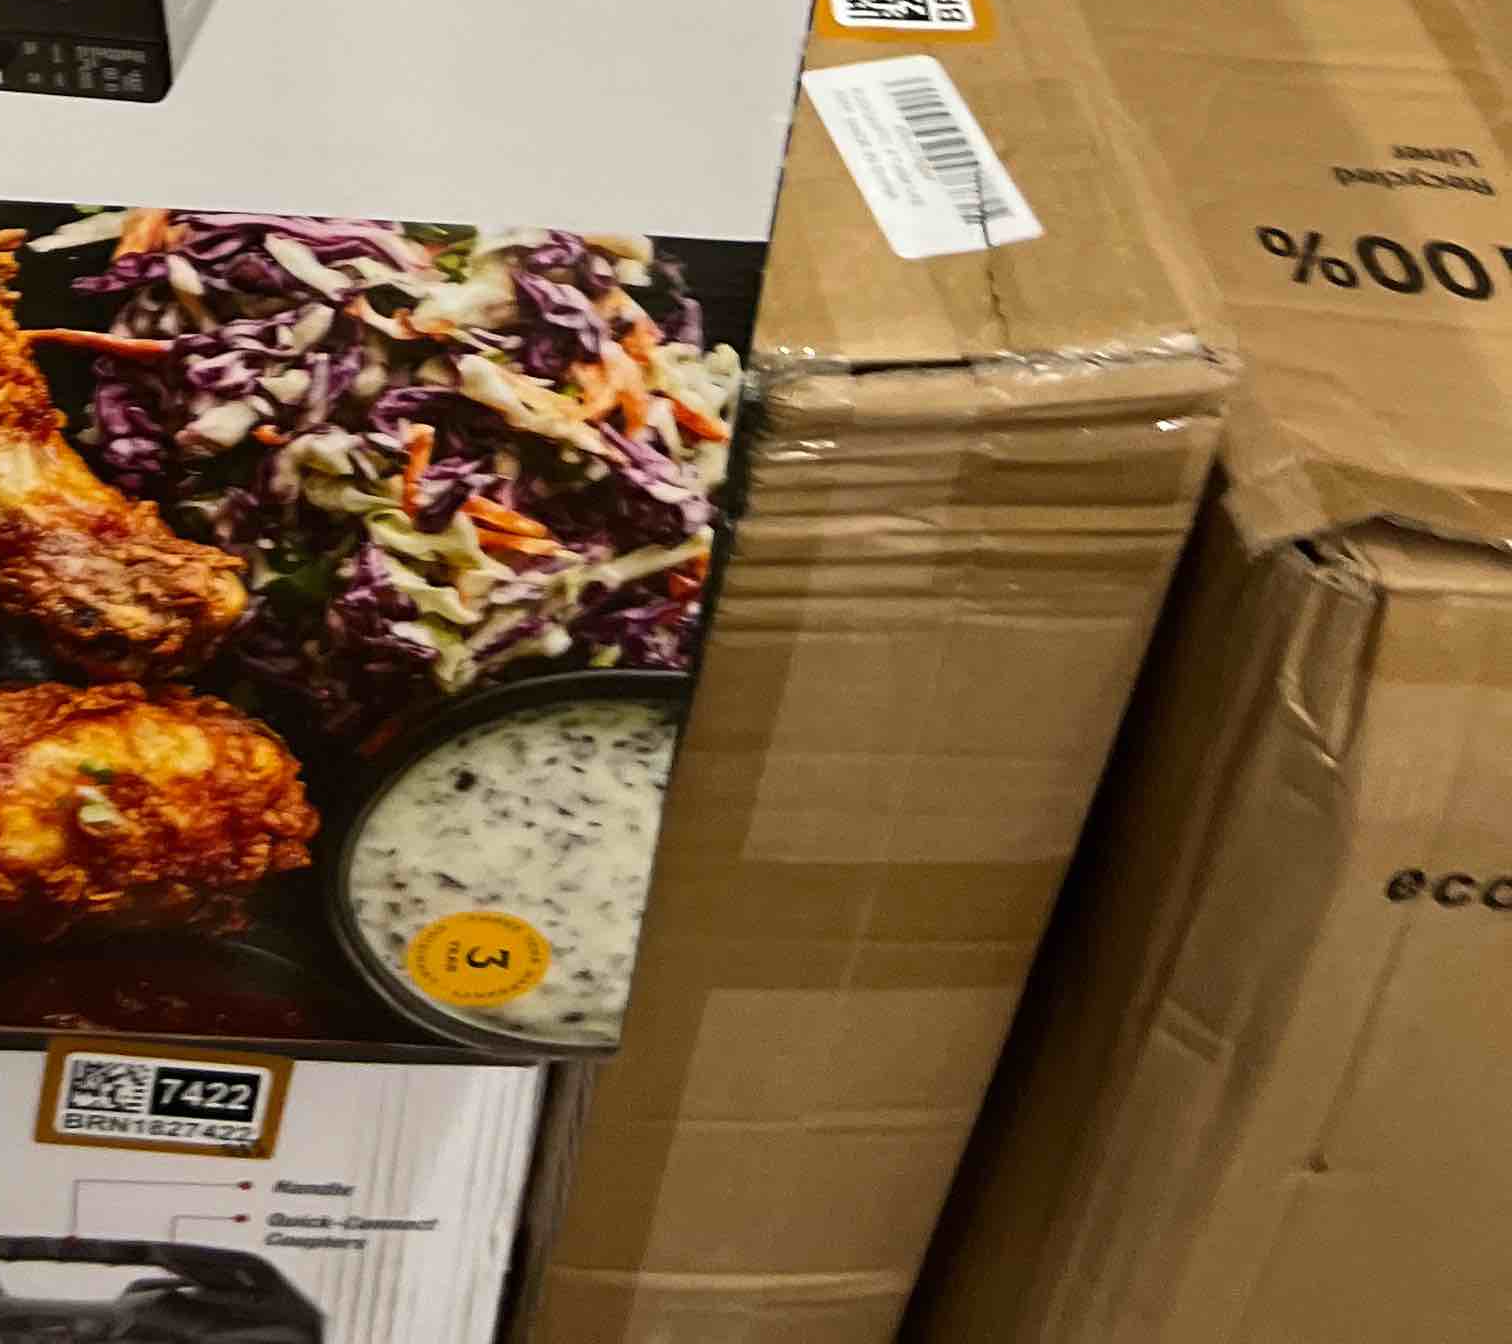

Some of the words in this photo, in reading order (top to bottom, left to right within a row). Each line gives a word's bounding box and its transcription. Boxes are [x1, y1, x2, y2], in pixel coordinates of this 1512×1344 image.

[1254, 226, 1512, 302] 00%
[465, 945, 510, 971] 3
[157, 1077, 253, 1111] 7422
[63, 1112, 253, 1141] BRN1827422
